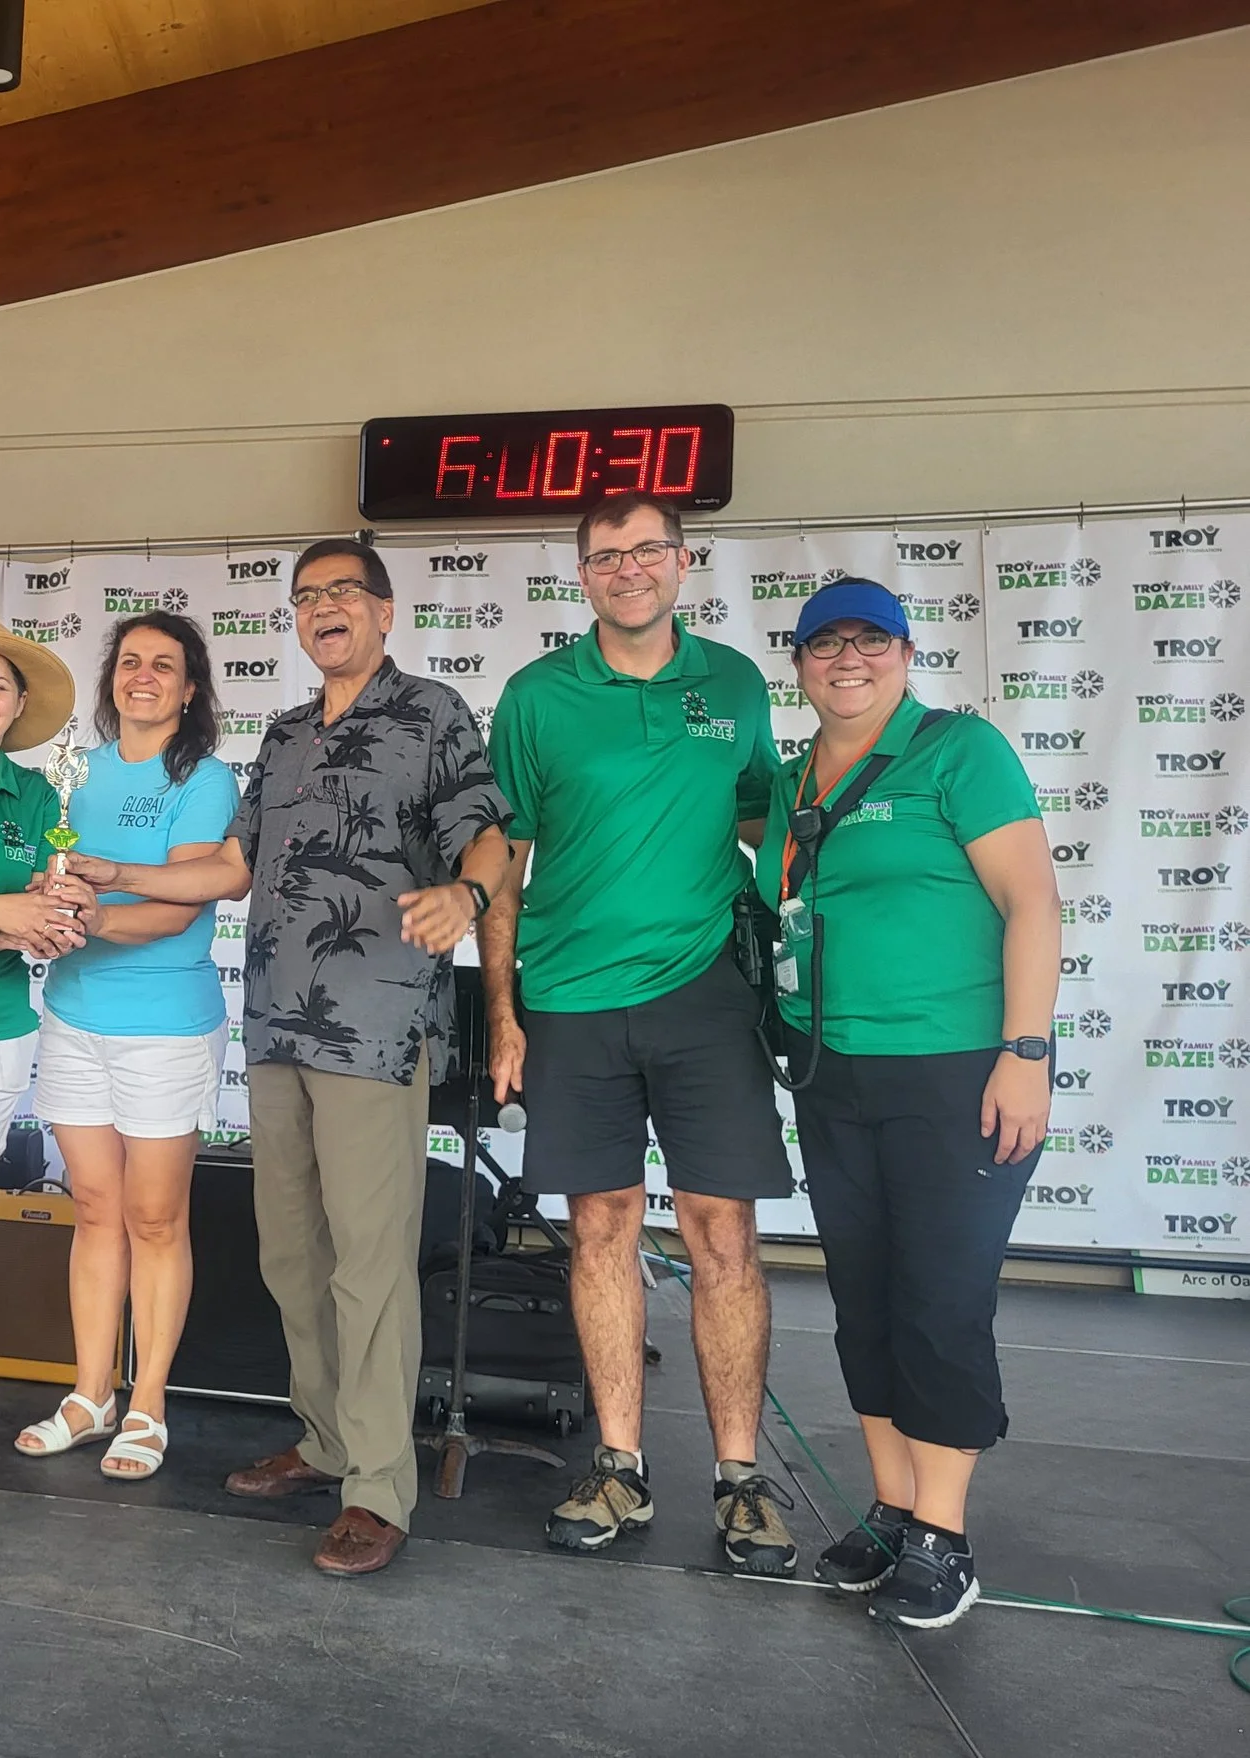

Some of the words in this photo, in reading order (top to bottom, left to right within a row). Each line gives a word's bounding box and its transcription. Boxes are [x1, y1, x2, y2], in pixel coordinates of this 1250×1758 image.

[1150, 525, 1220, 548] TROY
[897, 540, 962, 560] TROY
[227, 558, 281, 579] TROY
[429, 552, 488, 572] TROY
[996, 560, 1034, 573] TROY
[1034, 563, 1066, 571] FAMILY
[25, 567, 71, 589] TROY
[526, 575, 558, 585] TROY
[751, 571, 785, 583] TROY
[999, 571, 1067, 590] DAZE!
[104, 587, 134, 597] TROY
[752, 581, 817, 600] DAZE!
[1133, 581, 1171, 593] TROY
[413, 603, 444, 613] TROY
[1135, 593, 1205, 611] DAZE!
[212, 609, 241, 620] TROY
[415, 614, 471, 629] DAZE!
[904, 605, 944, 622] AZE!
[11, 618, 38, 628] TROY
[213, 620, 266, 636] DAZE!
[1017, 617, 1083, 638] TROY
[541, 632, 582, 648] TRO
[767, 631, 795, 647] TR
[1153, 636, 1222, 657] TROY
[427, 654, 484, 673] TROY
[913, 648, 960, 668] ROY
[224, 658, 278, 676] TROY
[1001, 670, 1038, 683] TROY
[1003, 683, 1067, 700] DAZE!
[1136, 694, 1174, 705] TROY
[1139, 707, 1206, 723] DAZE!
[223, 720, 262, 735] AZE!
[686, 723, 735, 742] DAZE!
[1021, 729, 1086, 750] TROY
[1156, 749, 1226, 771] TROY
[122, 795, 165, 814] GLOBAL
[1038, 796, 1071, 812] ZE!
[117, 814, 160, 828] TROY
[1140, 809, 1175, 819] TROY
[1141, 821, 1211, 837] DAZE!
[1052, 841, 1090, 862] OY
[1158, 863, 1230, 886] TROY
[1142, 923, 1180, 934] TROY
[1181, 926, 1215, 934] FAMILY
[1144, 935, 1215, 952] DAZE!
[1061, 954, 1093, 974] OY
[219, 967, 241, 982] TR
[1162, 979, 1231, 1000] TROY
[1144, 1038, 1183, 1049] TROY
[1146, 1051, 1214, 1068] DAZE!
[1055, 1068, 1091, 1089] OY
[1164, 1096, 1233, 1117] TROY
[429, 1137, 459, 1153] ZE!
[1145, 1155, 1181, 1166] TROY
[1182, 1159, 1216, 1167] FAMILY
[1147, 1168, 1217, 1185] DAZE!
[647, 1194, 674, 1210] TR
[1025, 1184, 1094, 1205] TROY
[1165, 1213, 1237, 1234] TROY
[1182, 1273, 1206, 1285] Arc
[1211, 1275, 1225, 1286] of
